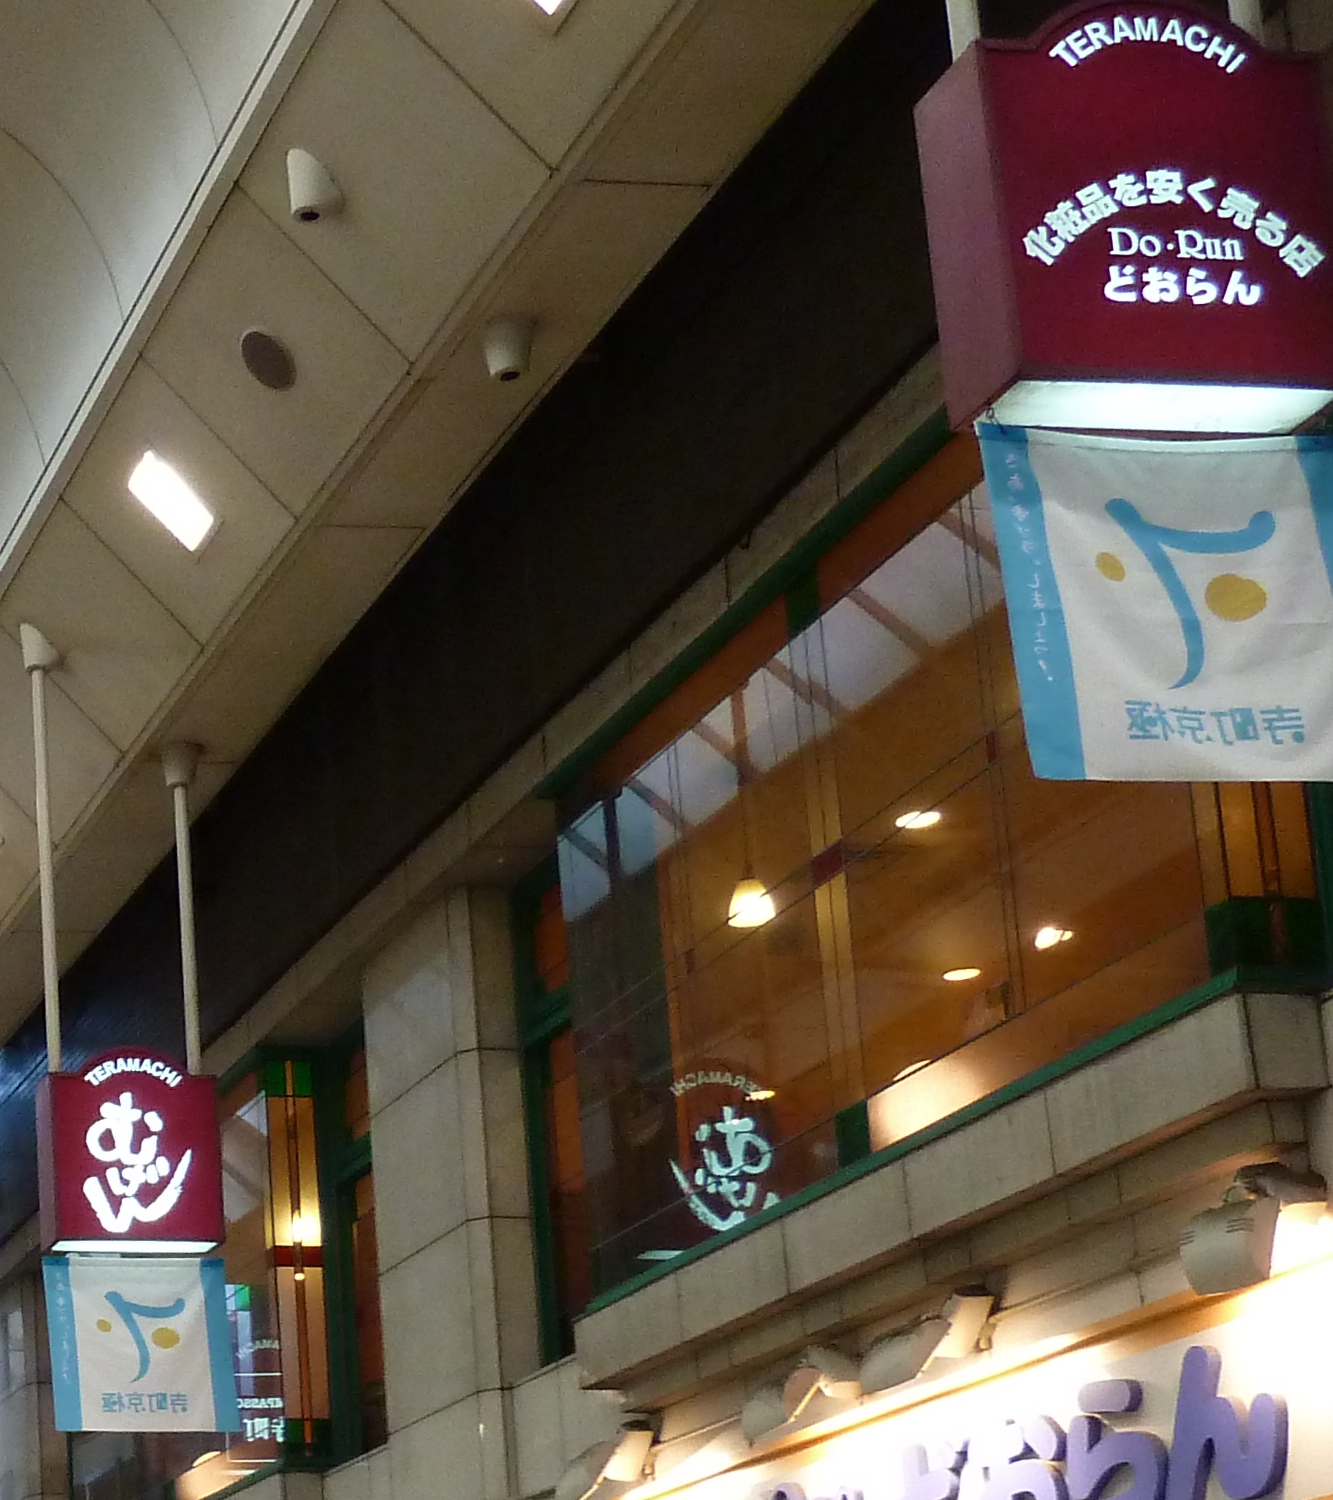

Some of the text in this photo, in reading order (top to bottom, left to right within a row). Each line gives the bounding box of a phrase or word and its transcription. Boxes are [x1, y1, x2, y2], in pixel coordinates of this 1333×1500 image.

[1049, 17, 1247, 74] TERAMACHI
[1022, 167, 1326, 279] 化粧品を安く売る店
[1103, 266, 1262, 306] どおらん
[85, 1058, 183, 1087] TERAMACHI
